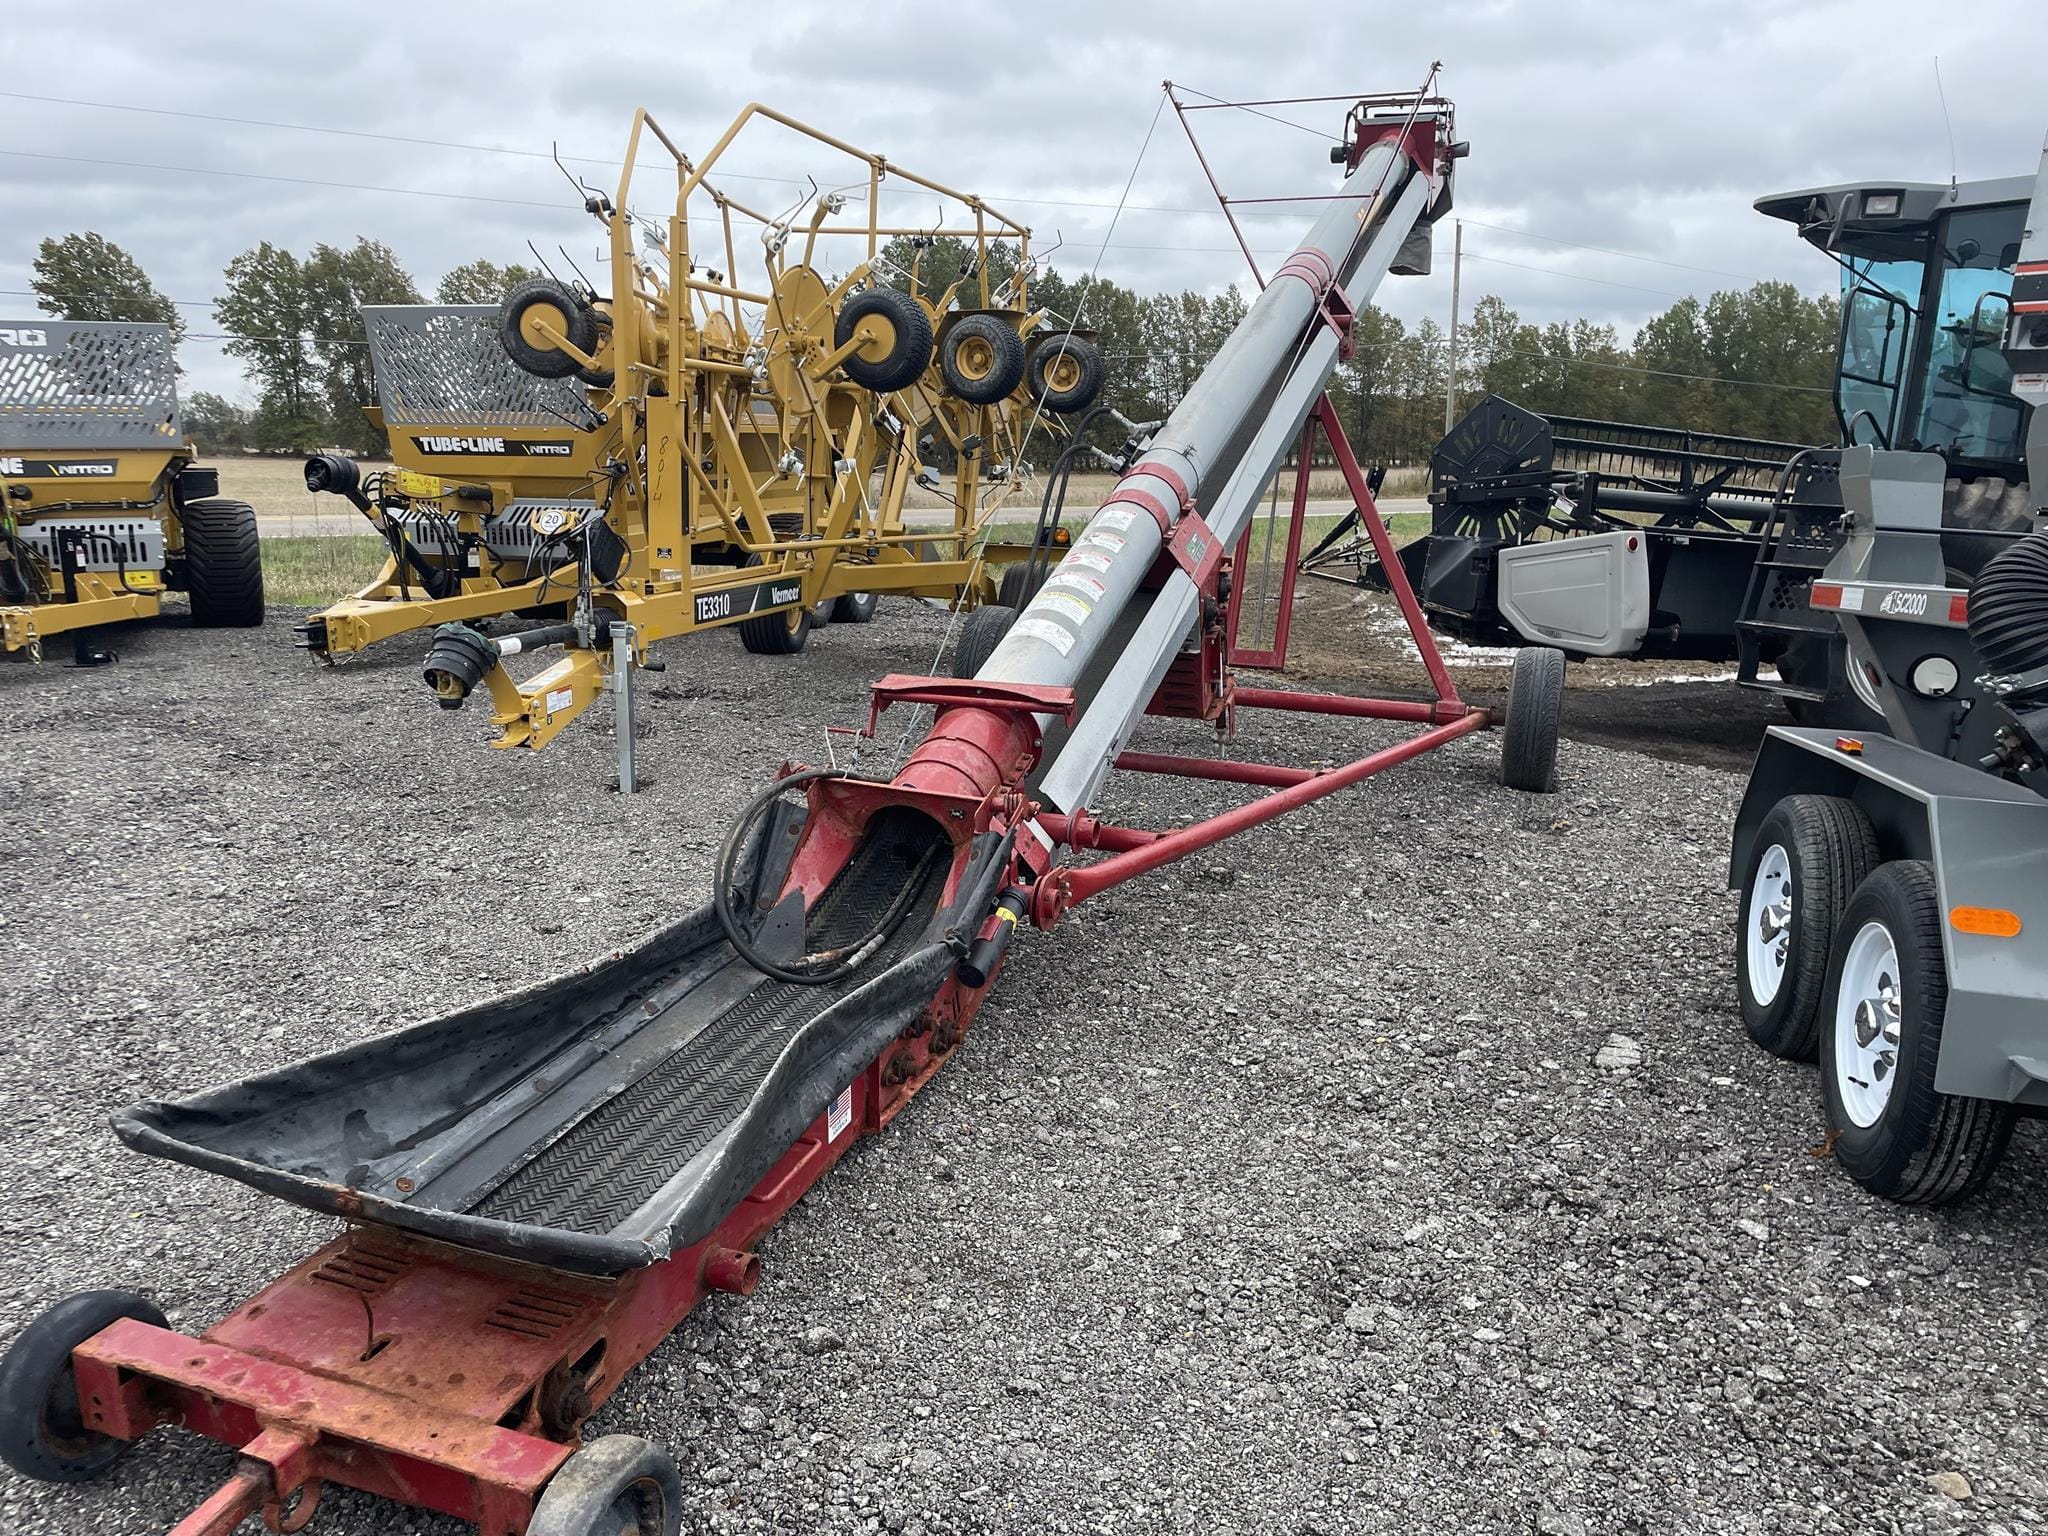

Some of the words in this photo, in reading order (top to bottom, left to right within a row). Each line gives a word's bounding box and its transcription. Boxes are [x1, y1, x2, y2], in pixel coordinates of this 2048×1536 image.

[529, 445, 570, 455] NITRO
[58, 464, 114, 475] NITRO
[545, 514, 560, 525] 20
[696, 593, 731, 621] TE3310
[771, 585, 800, 605] Vermeer
